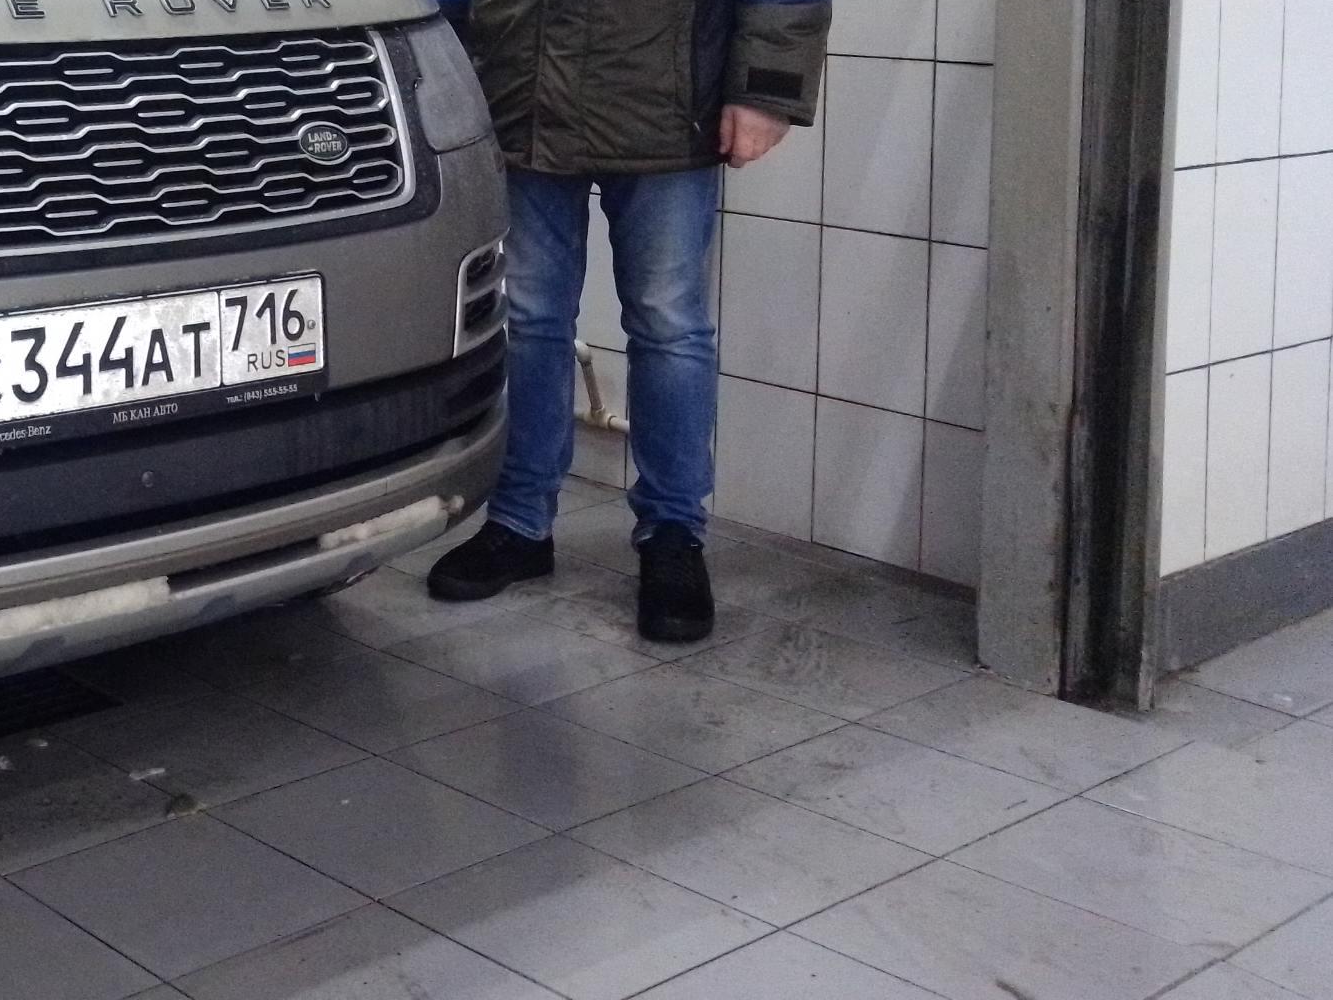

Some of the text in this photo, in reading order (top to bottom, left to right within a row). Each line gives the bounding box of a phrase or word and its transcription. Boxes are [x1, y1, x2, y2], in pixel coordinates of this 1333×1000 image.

[308, 131, 333, 142] LAND
[314, 141, 342, 154] ROVER
[224, 288, 306, 353] 716
[247, 349, 286, 373] RUS
[130, 407, 151, 421] КАН
[153, 402, 179, 417] АВТО
